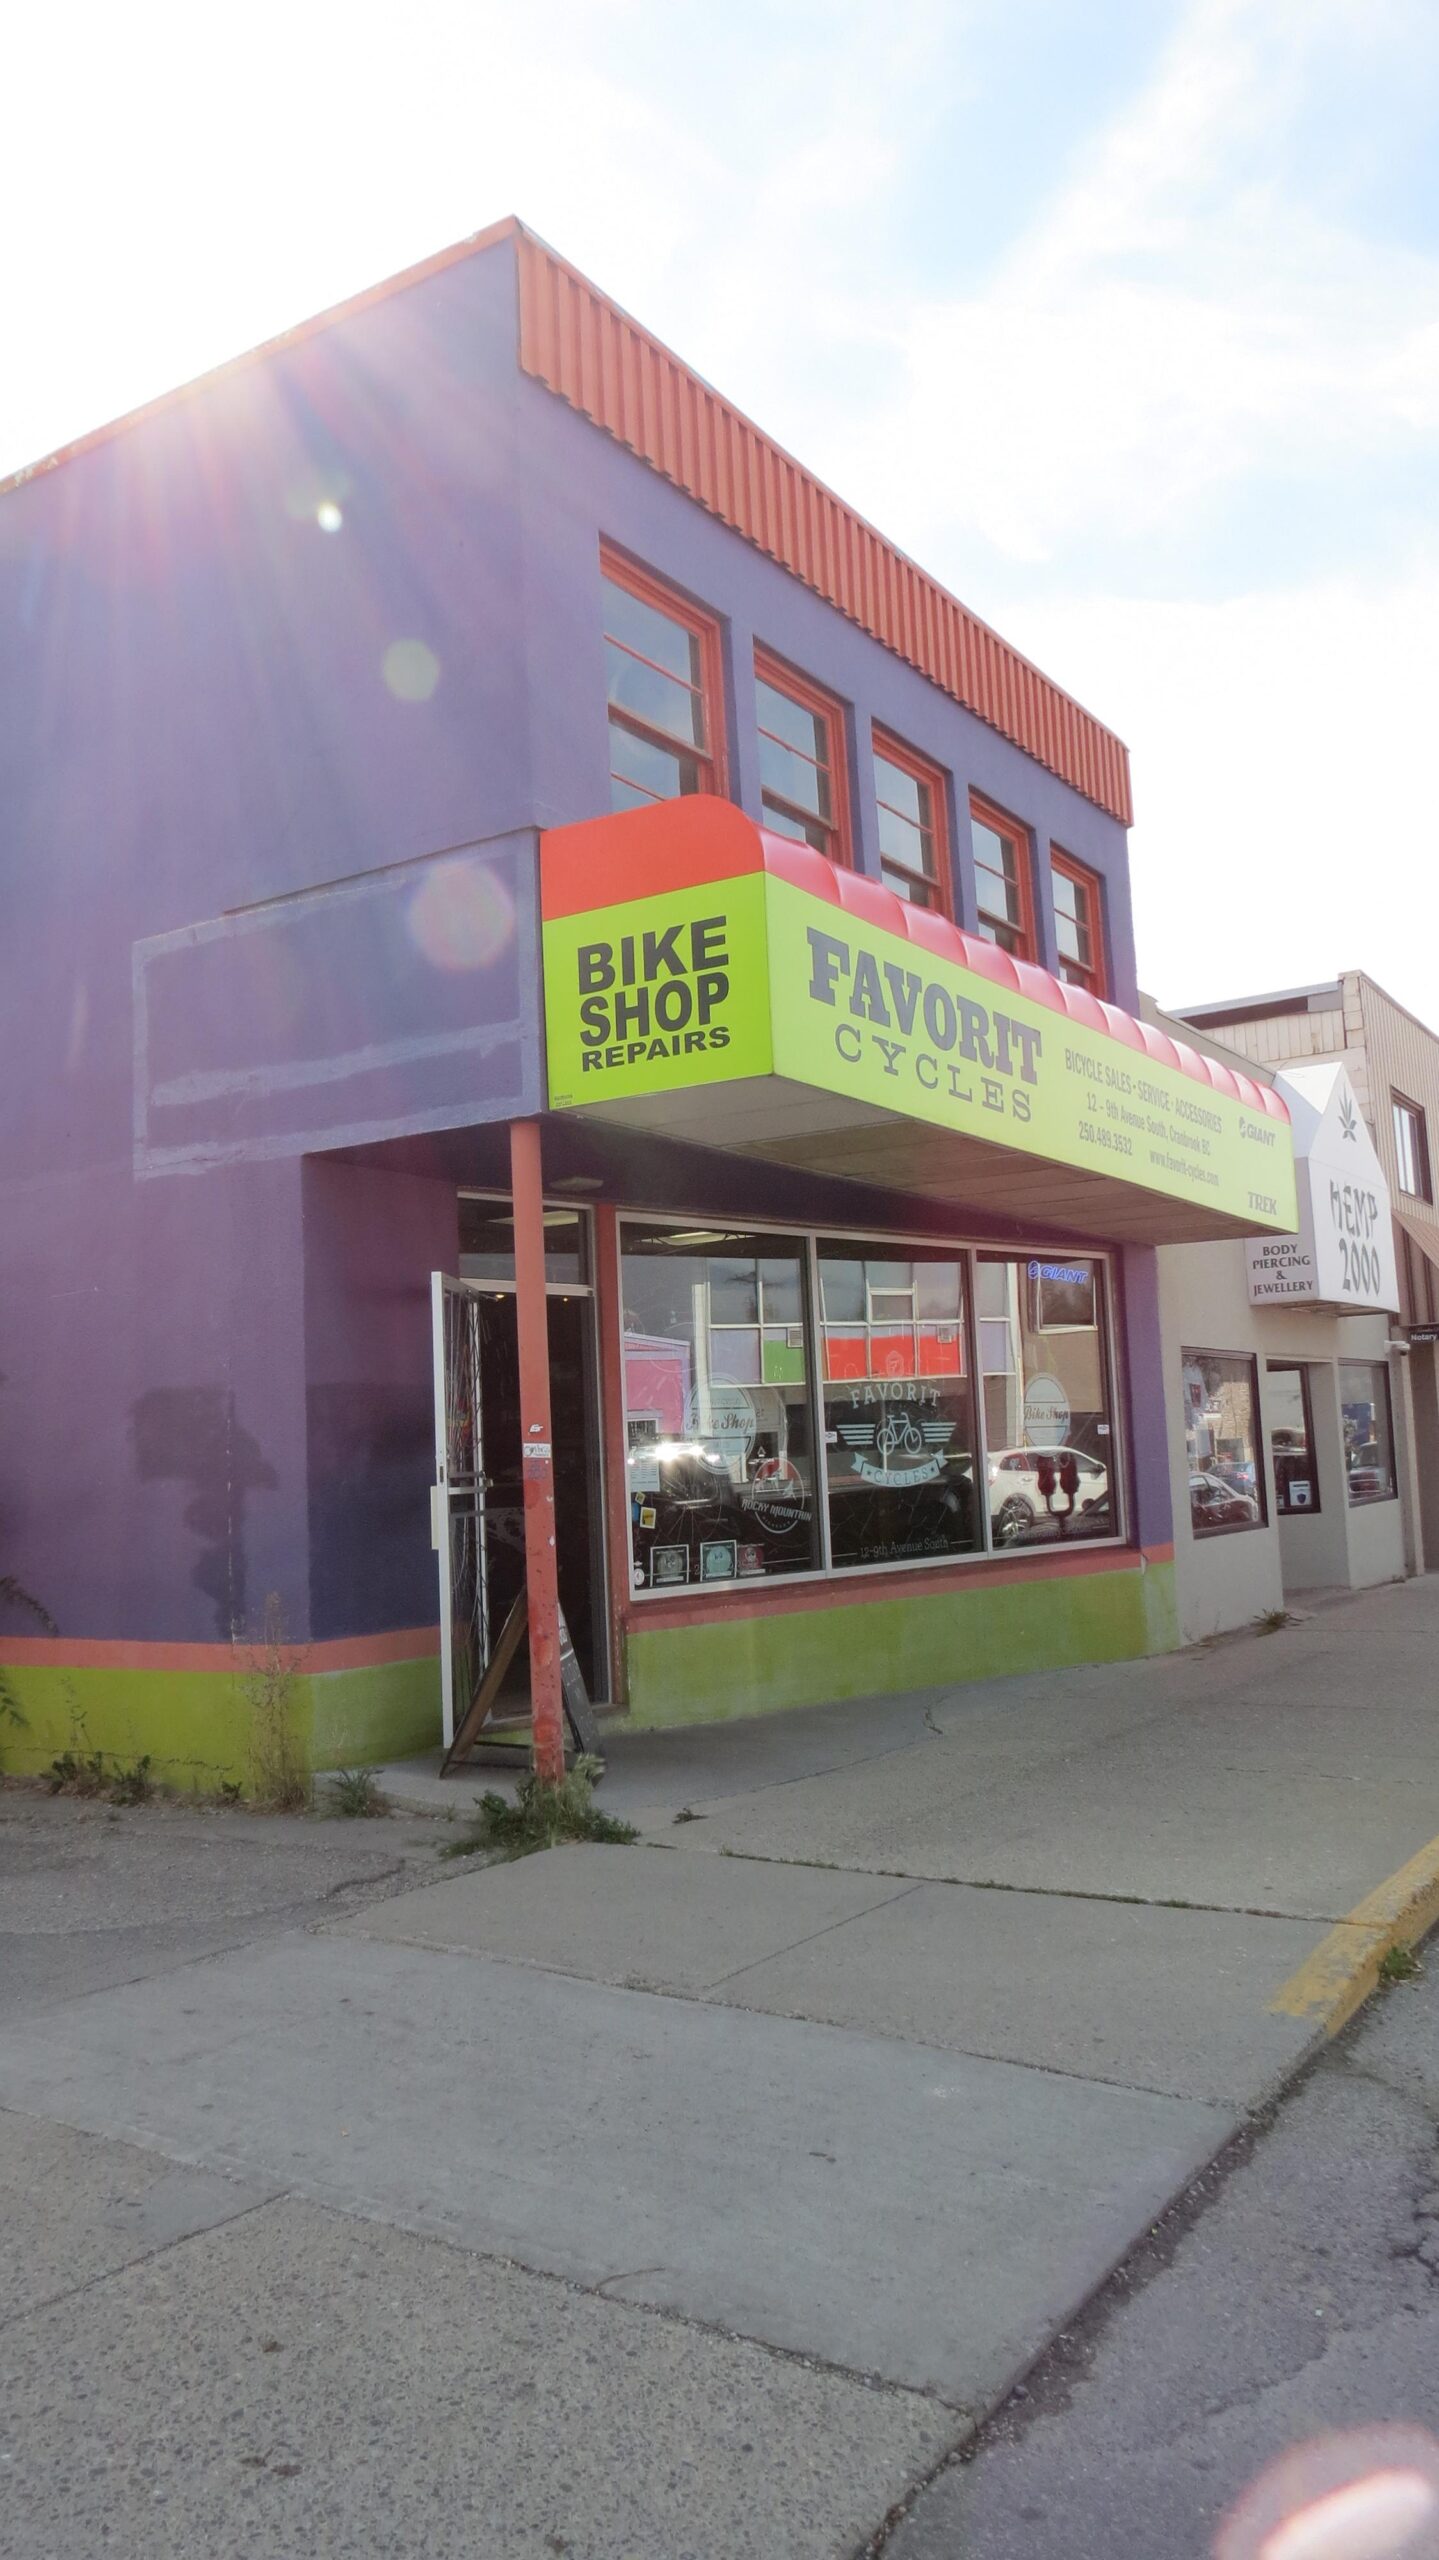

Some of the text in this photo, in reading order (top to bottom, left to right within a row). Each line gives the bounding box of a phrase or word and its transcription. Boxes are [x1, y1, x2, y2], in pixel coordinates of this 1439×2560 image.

[578, 915, 729, 995] BIKE
[580, 972, 730, 1047] SHOP
[807, 926, 1042, 1085] FAVORIT
[582, 1027, 731, 1072] REPAIRS
[834, 1023, 1032, 1123] CYCLES
[1065, 1048, 1222, 1134] BICYCLE SALES SERVICE ACCESSORIES
[1087, 1091, 1097, 1112] 12
[1106, 1099, 1118, 1120] 9th
[1120, 1105, 1145, 1130] Avenue
[1247, 1123, 1276, 1147] GIANT
[1247, 1191, 1278, 1216] TREK
[1330, 1179, 1378, 1240] HEMP
[1252, 1255, 1311, 1269] PIERCING
[1262, 1244, 1298, 1257] BODY
[1040, 1264, 1089, 1284] GIANT
[1276, 1270, 1287, 1280] &
[1339, 1237, 1380, 1297] 2000
[1253, 1280, 1313, 1296] JEWELLERY
[1410, 1333, 1437, 1343] Notary
[851, 1382, 941, 1409] FAVORIT
[720, 1413, 753, 1434] Shop
[1024, 1405, 1069, 1421] Bike Shop
[873, 1468, 928, 1486] CYCLES
[741, 1499, 812, 1521] ROCKY MOUNTAIN
[889, 1541, 922, 1554] Avenue
